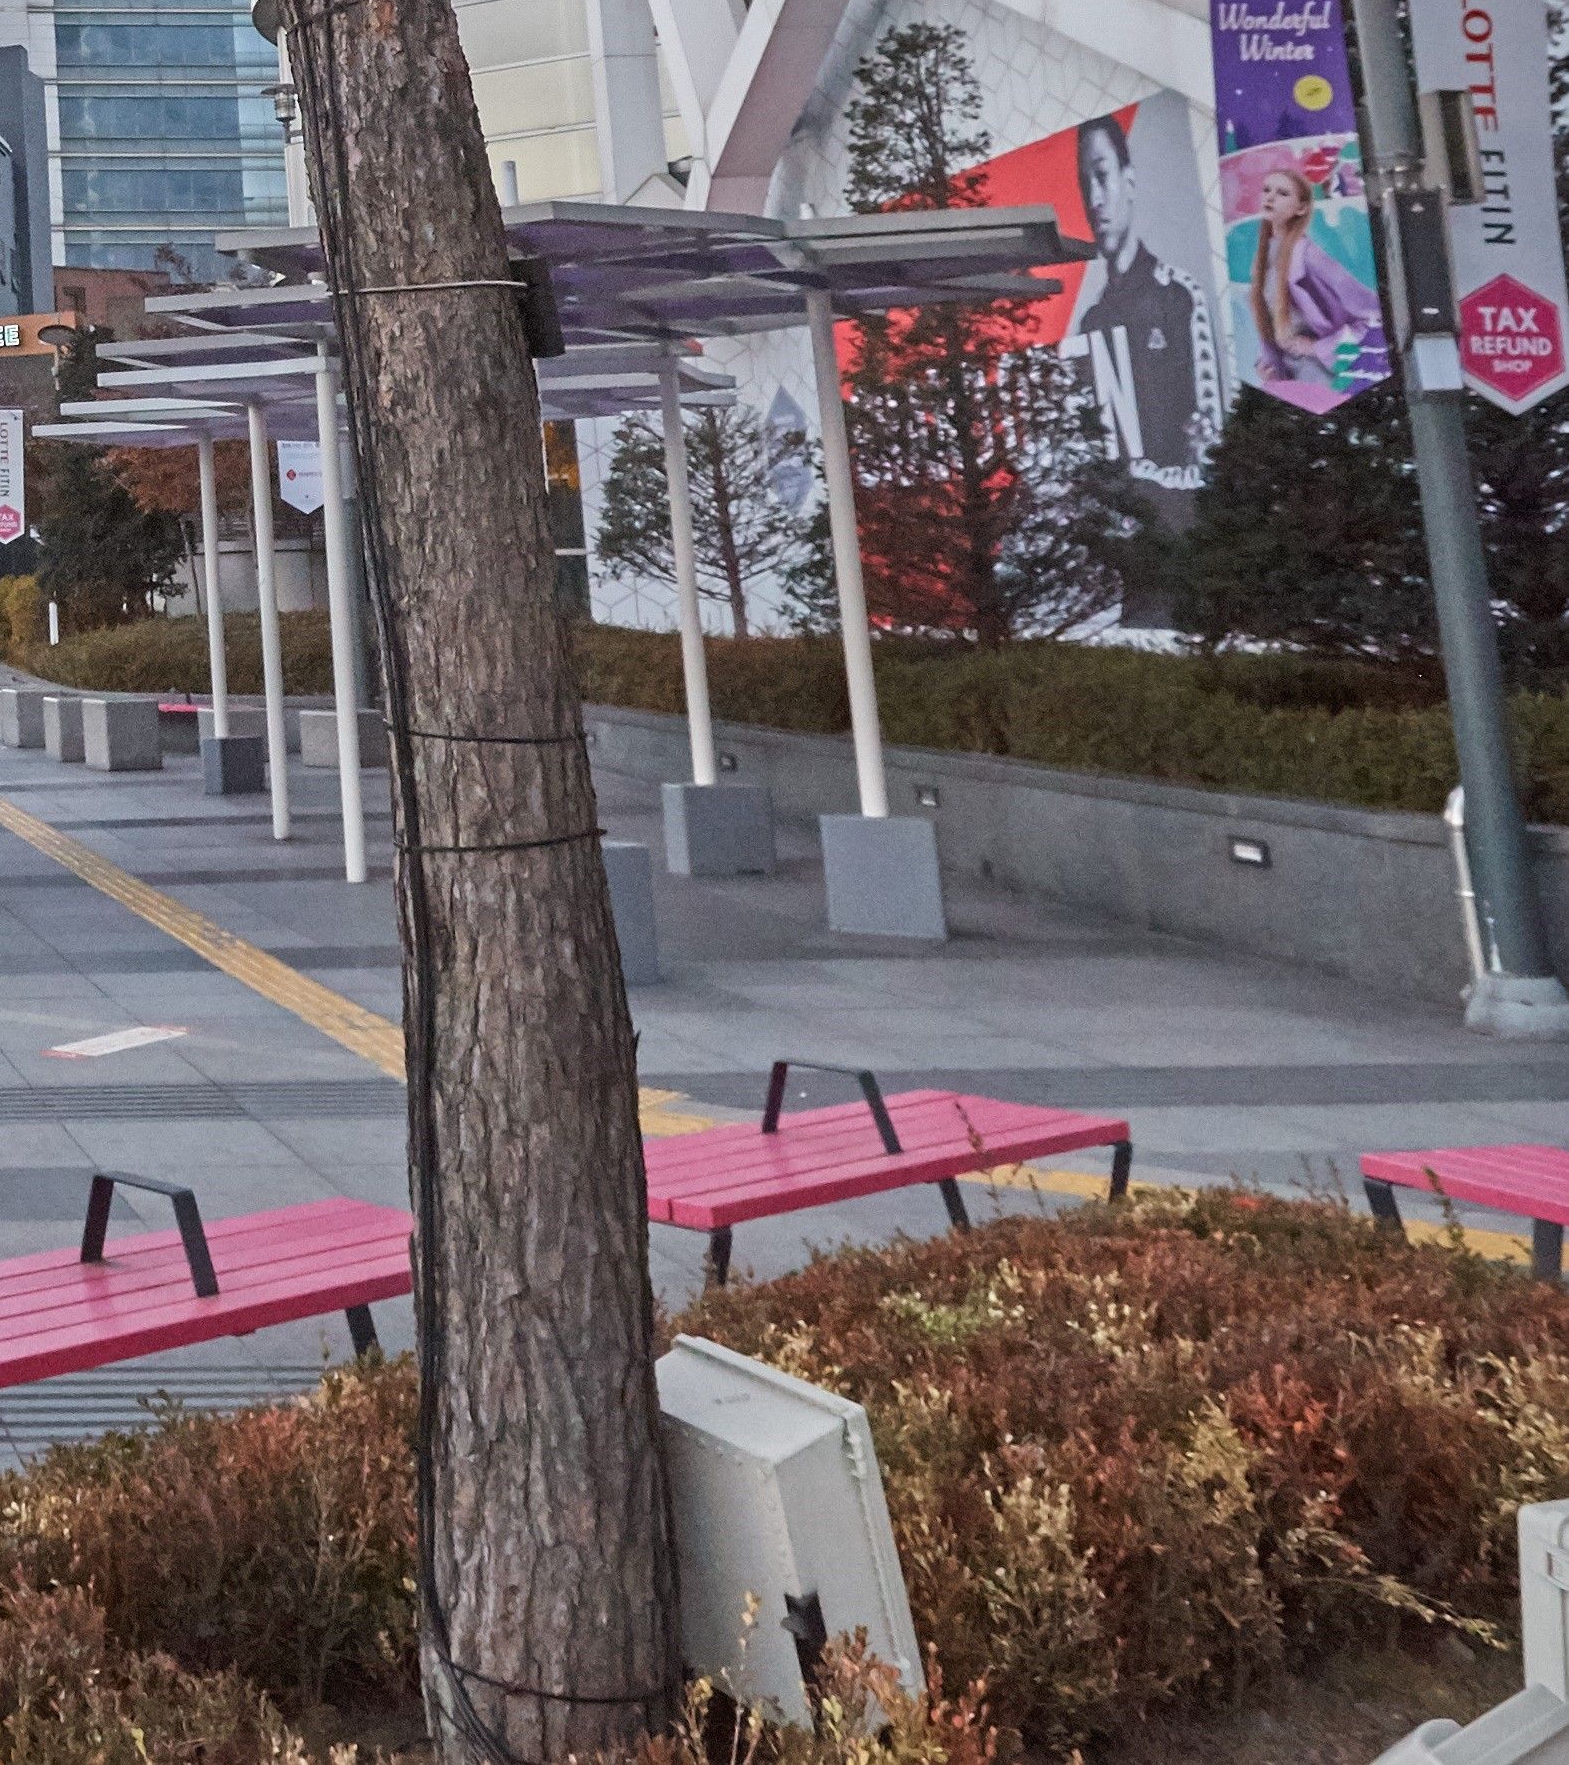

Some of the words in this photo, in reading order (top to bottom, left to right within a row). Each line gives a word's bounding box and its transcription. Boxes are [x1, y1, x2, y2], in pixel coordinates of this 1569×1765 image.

[1218, 1, 1331, 36] Wonderful
[1240, 33, 1315, 61] Winter
[1477, 307, 1540, 333] TAX
[1470, 335, 1553, 356] REFUND
